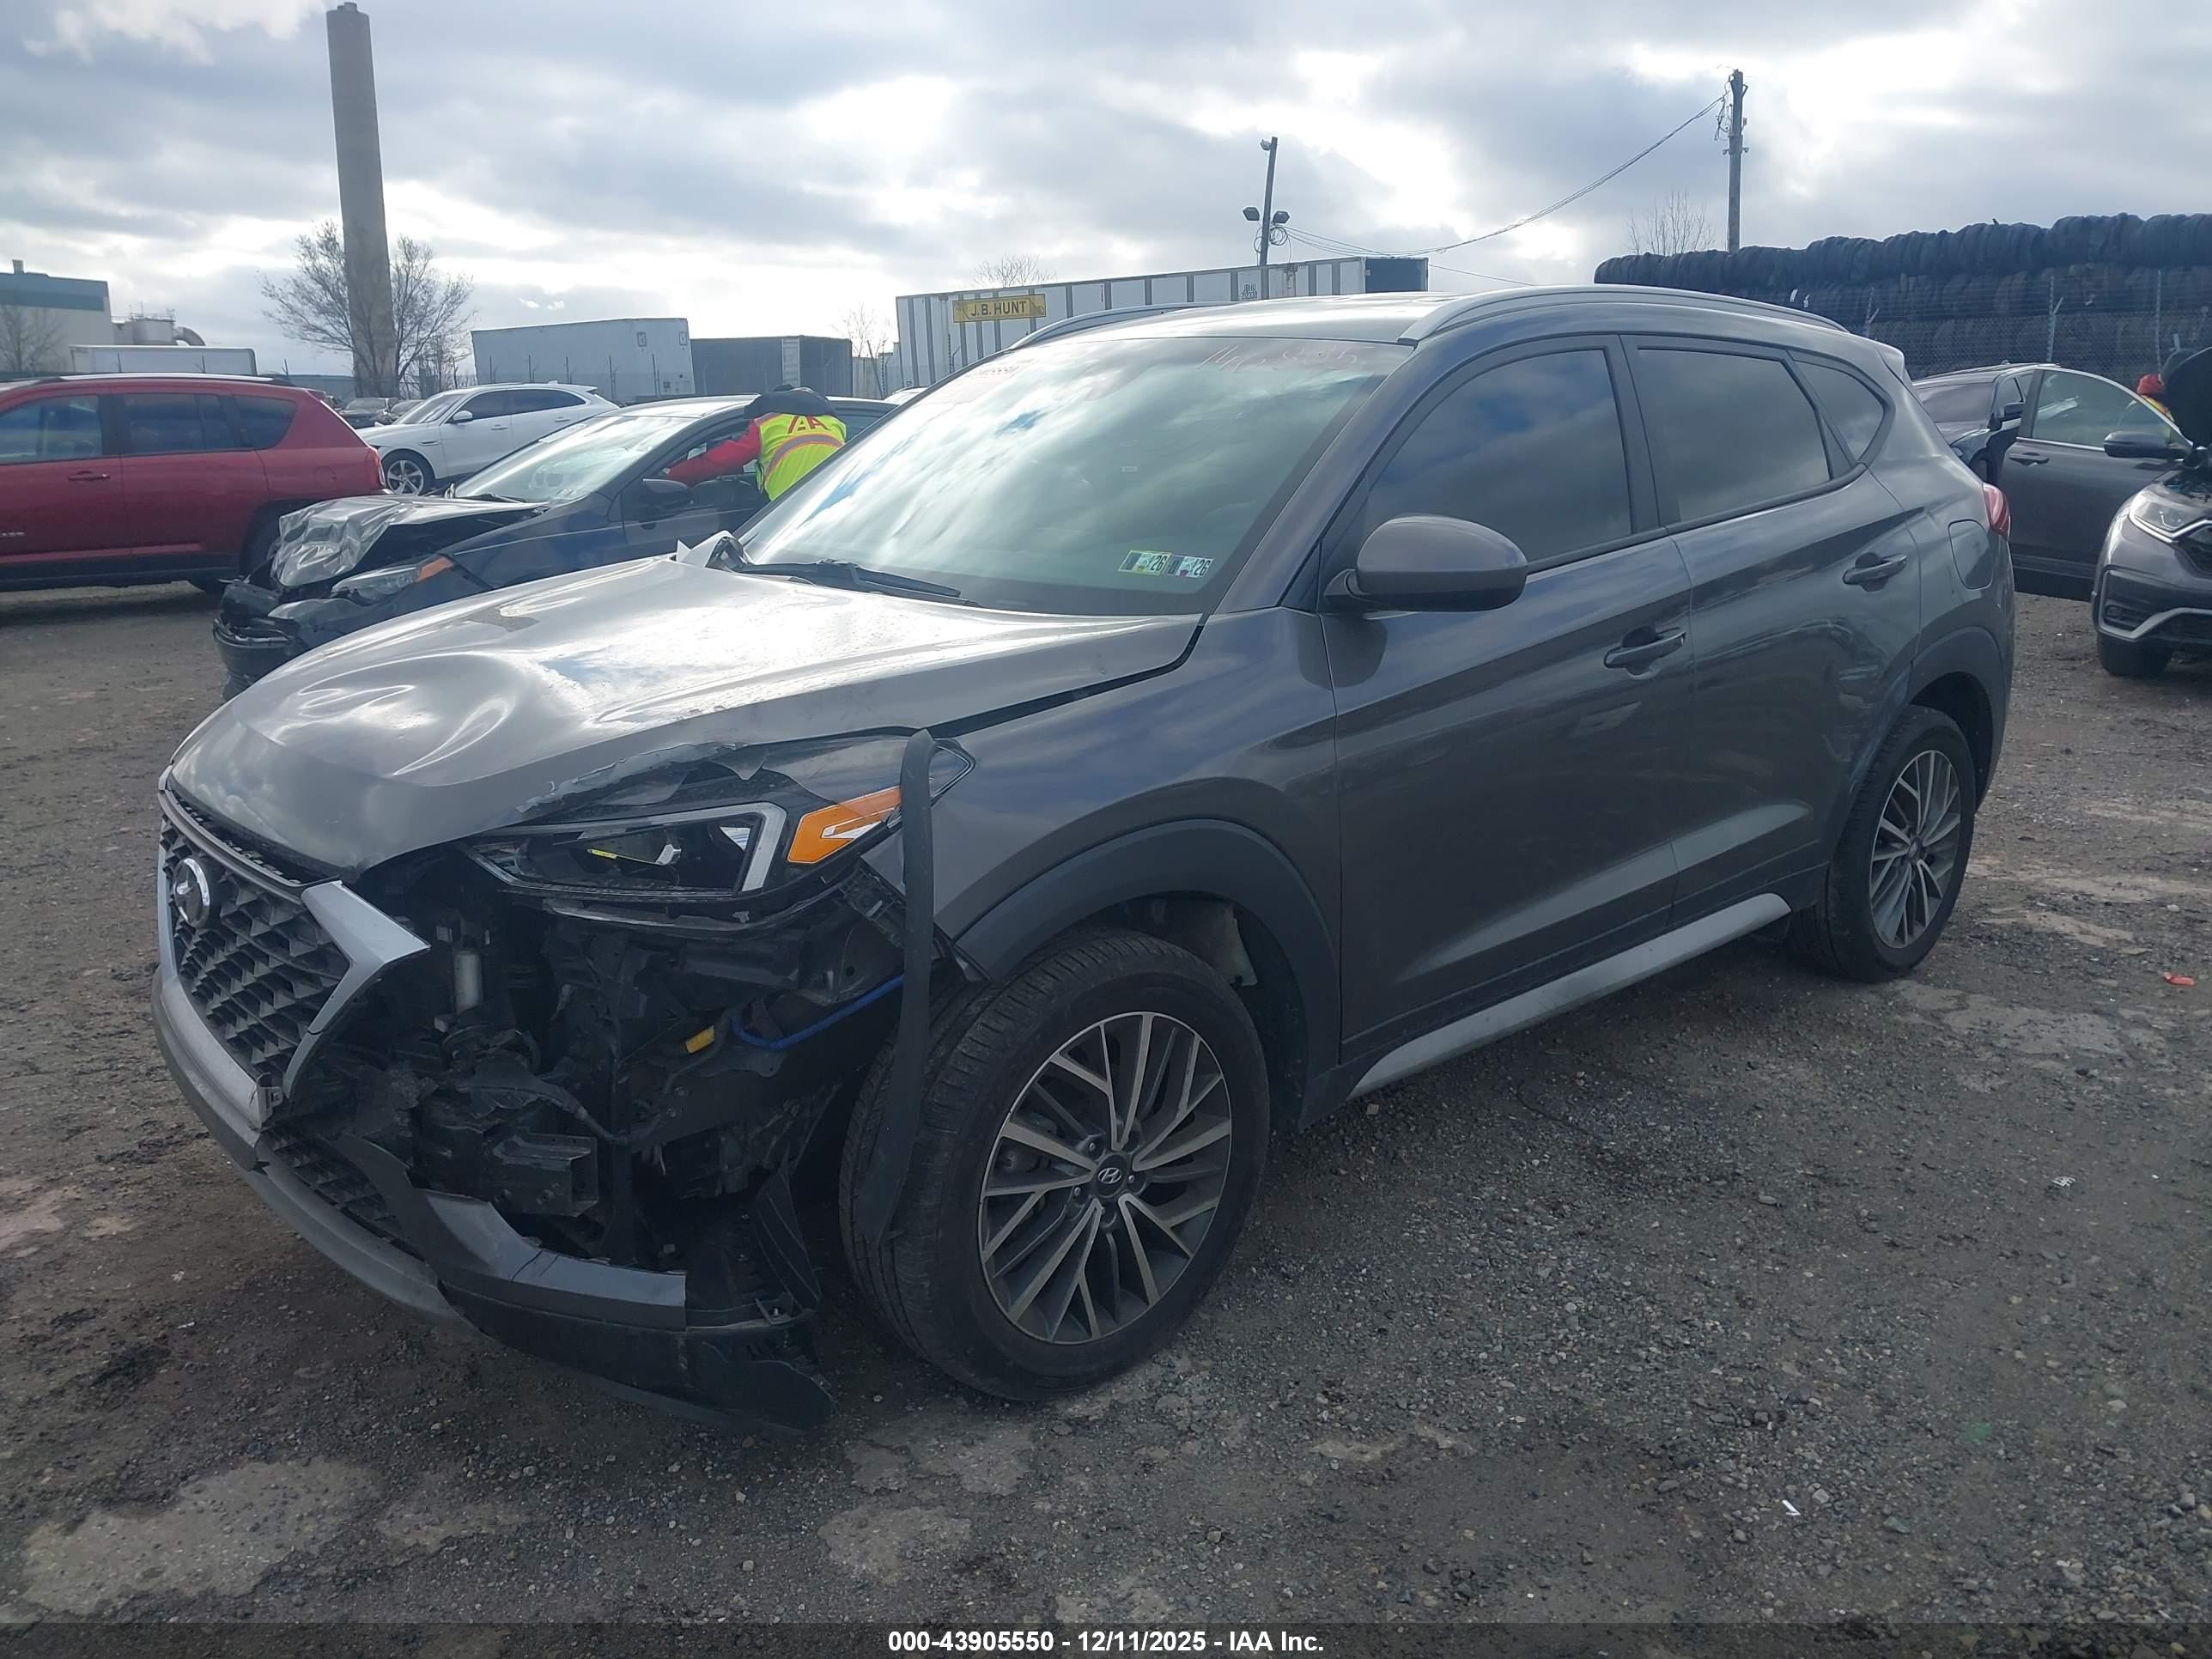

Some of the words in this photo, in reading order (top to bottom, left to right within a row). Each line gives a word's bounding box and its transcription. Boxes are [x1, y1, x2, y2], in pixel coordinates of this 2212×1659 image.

[994, 301, 1026, 315] HUNT
[1151, 555, 1167, 571] 26
[1194, 559, 1211, 576] 26
